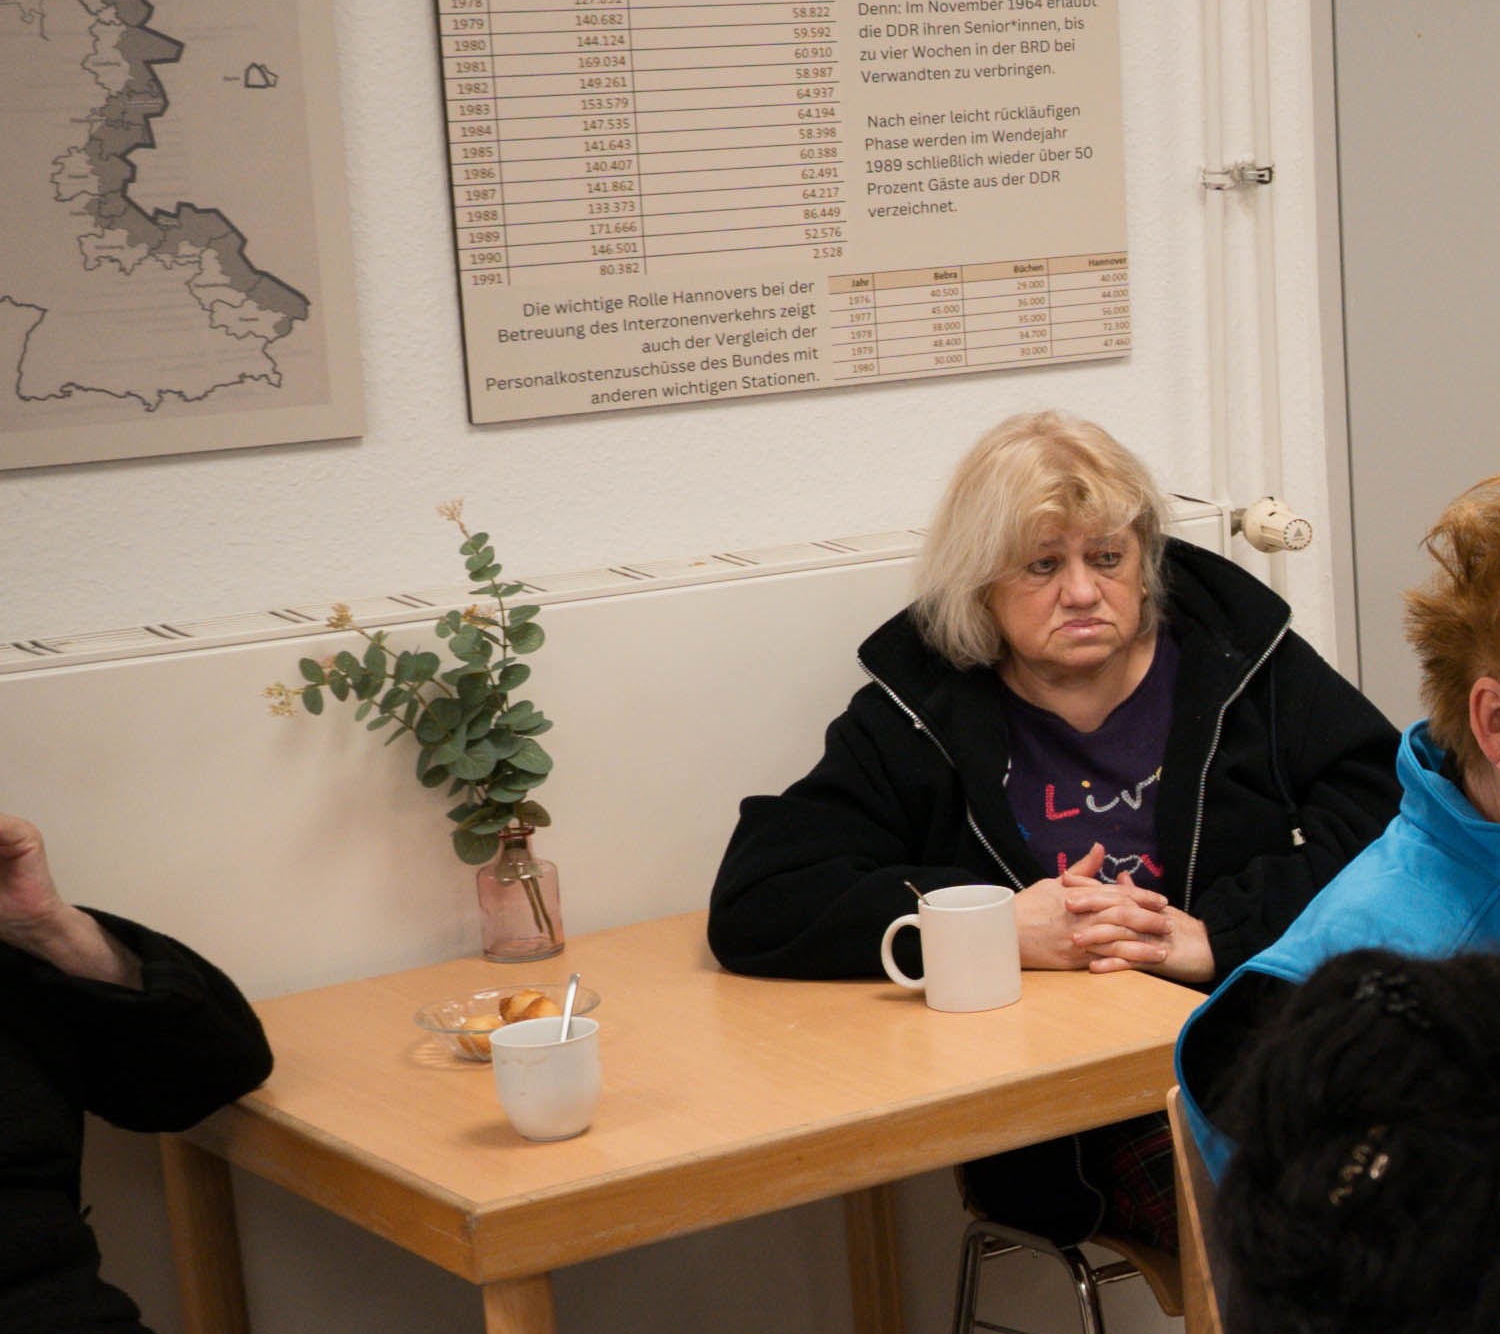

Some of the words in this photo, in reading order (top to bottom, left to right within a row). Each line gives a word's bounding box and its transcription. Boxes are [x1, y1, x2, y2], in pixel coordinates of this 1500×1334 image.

[522, 301, 550, 317] Die
[554, 296, 623, 314] wichtige
[627, 292, 668, 307] Rolle
[672, 286, 757, 303] Hannovers
[761, 281, 784, 296] bei
[788, 280, 814, 294] der
[497, 324, 586, 343] Betreuung
[589, 320, 618, 335] des
[622, 306, 776, 331] Interzonenverkehrs
[779, 302, 816, 319] zeigt
